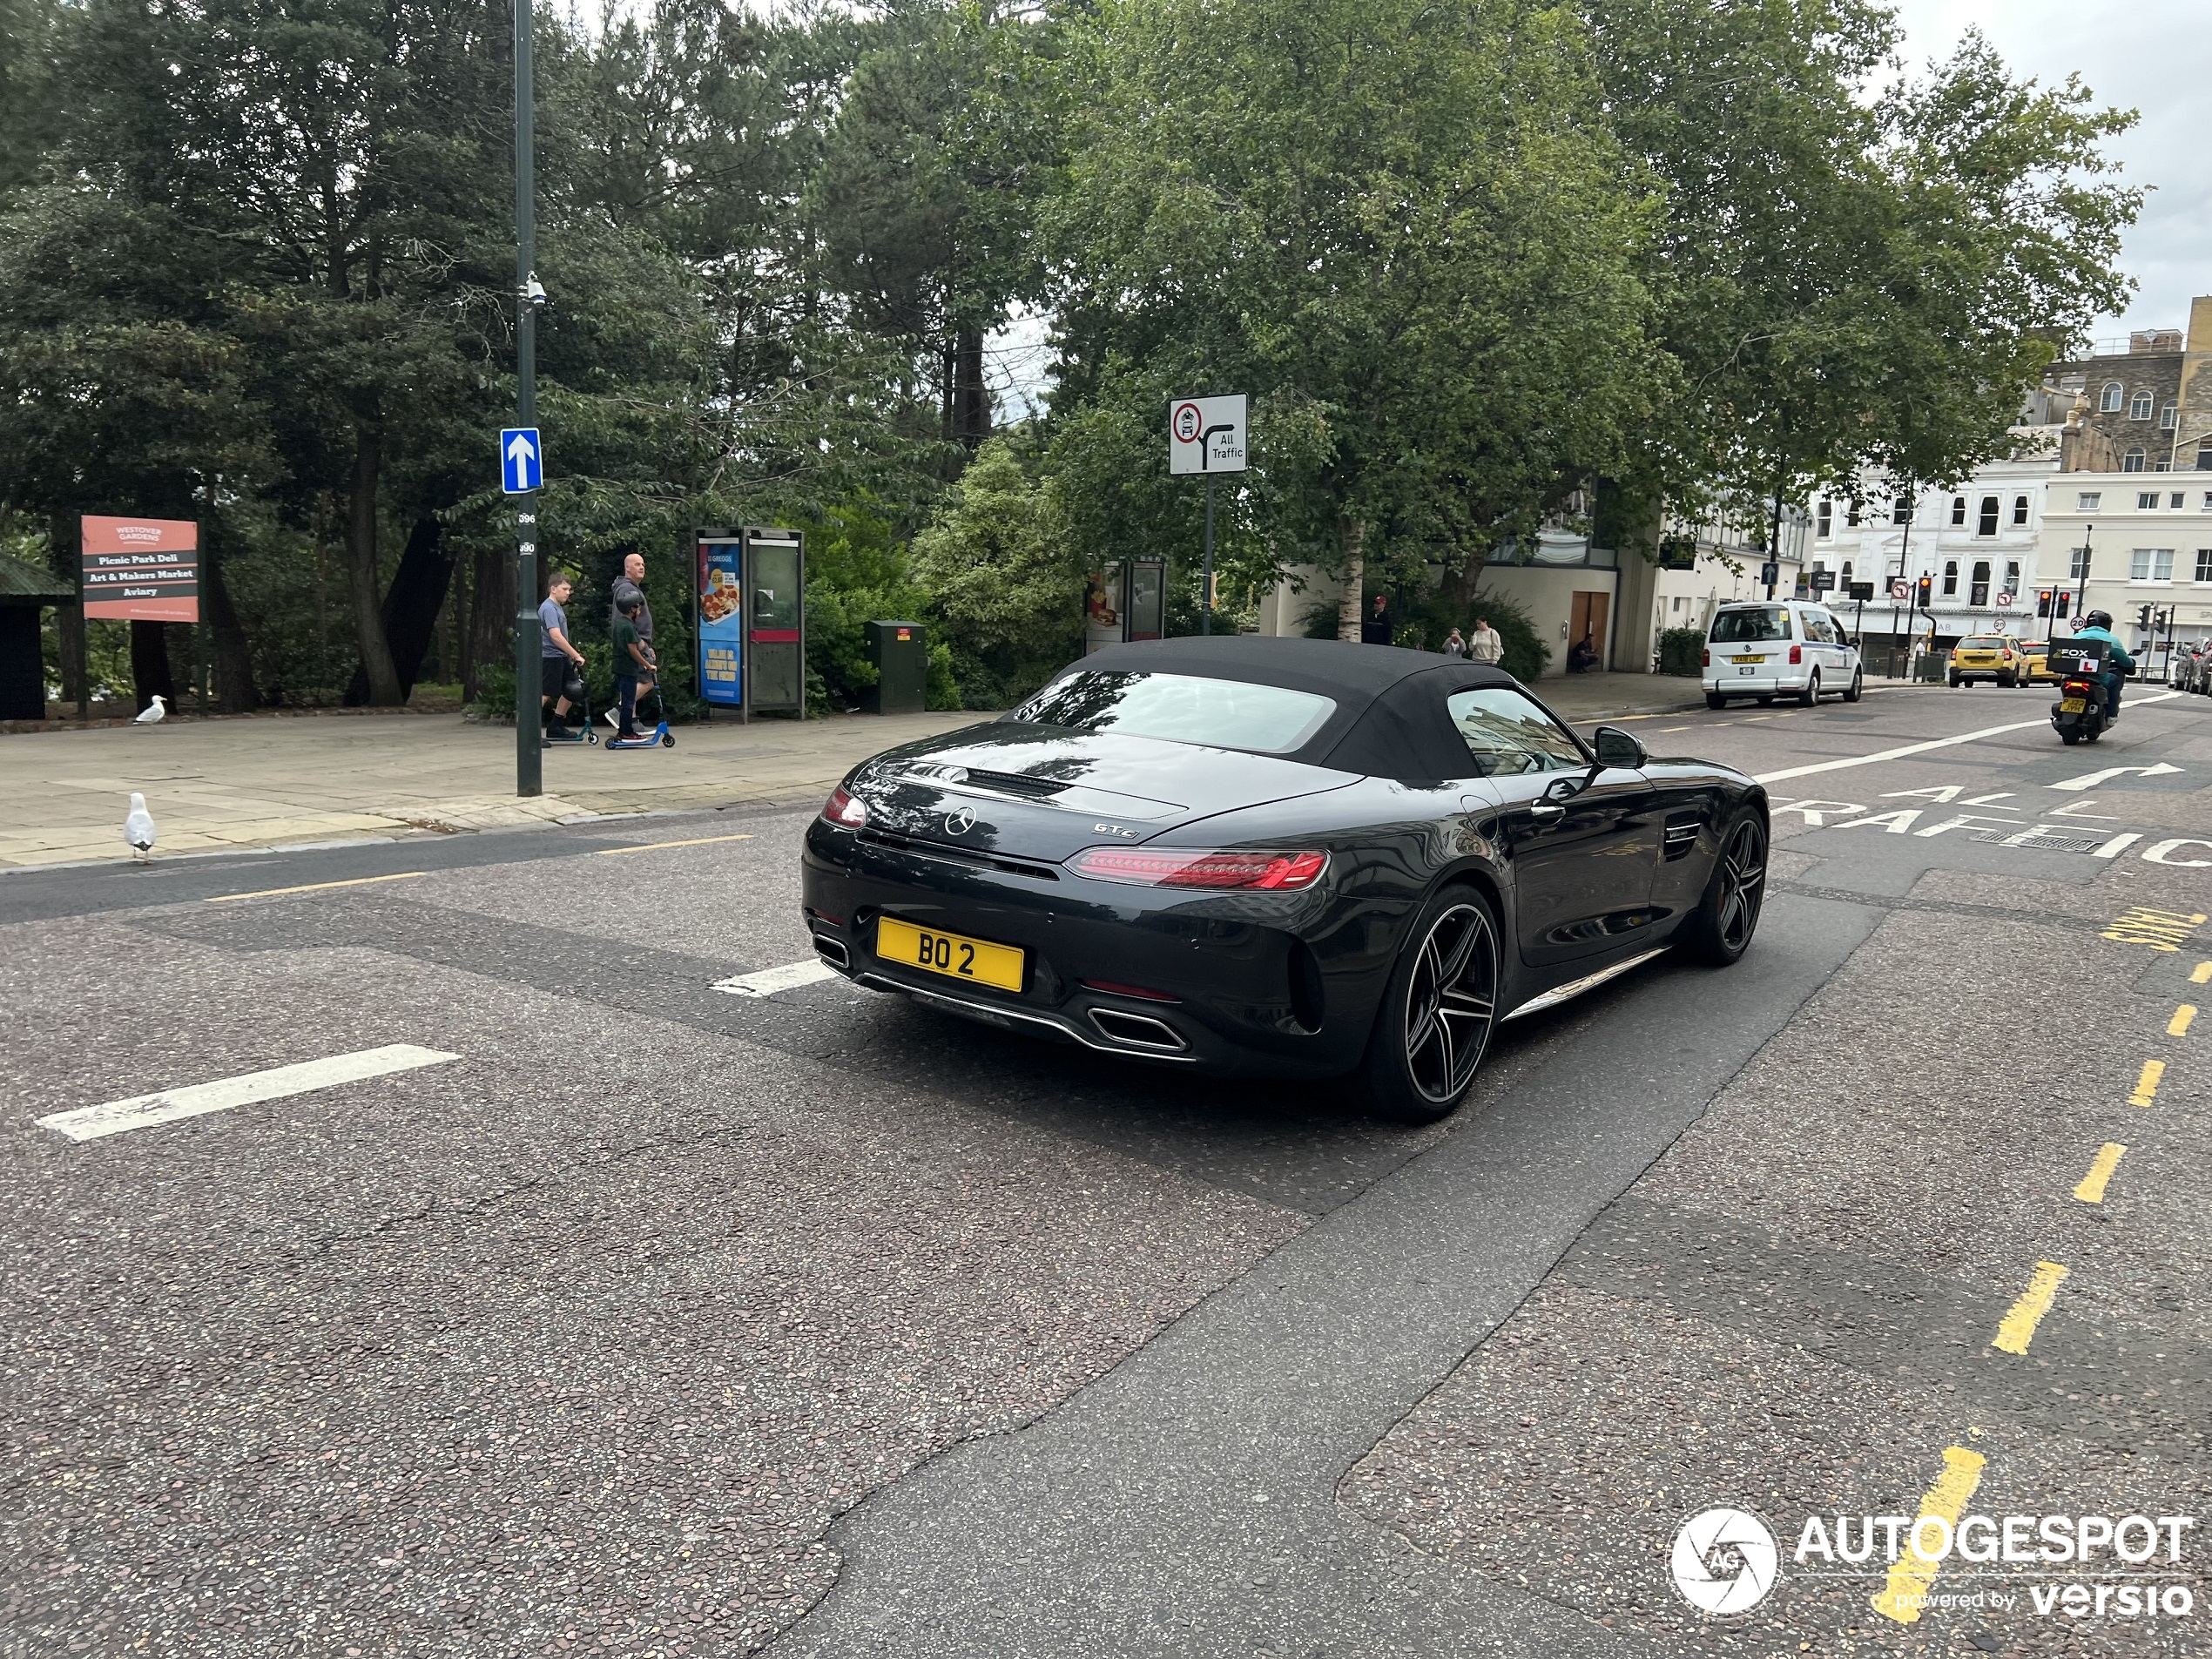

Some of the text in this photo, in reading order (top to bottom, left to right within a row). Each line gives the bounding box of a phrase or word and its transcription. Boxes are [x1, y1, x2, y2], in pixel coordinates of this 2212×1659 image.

[1220, 434, 1234, 445] All
[1212, 448, 1244, 459] Traffic
[116, 526, 163, 536] WESTOVER
[118, 533, 160, 542] GARDENS
[98, 553, 179, 565] Picnic Park Deli
[89, 570, 193, 583] Art & Makers Market
[123, 587, 158, 597] Aviary
[2060, 648, 2089, 658] FOX
[2083, 661, 2093, 671] L
[1878, 785, 2121, 820] ALL
[1769, 796, 2212, 867] RAFFIC
[918, 933, 975, 976] BO 2
